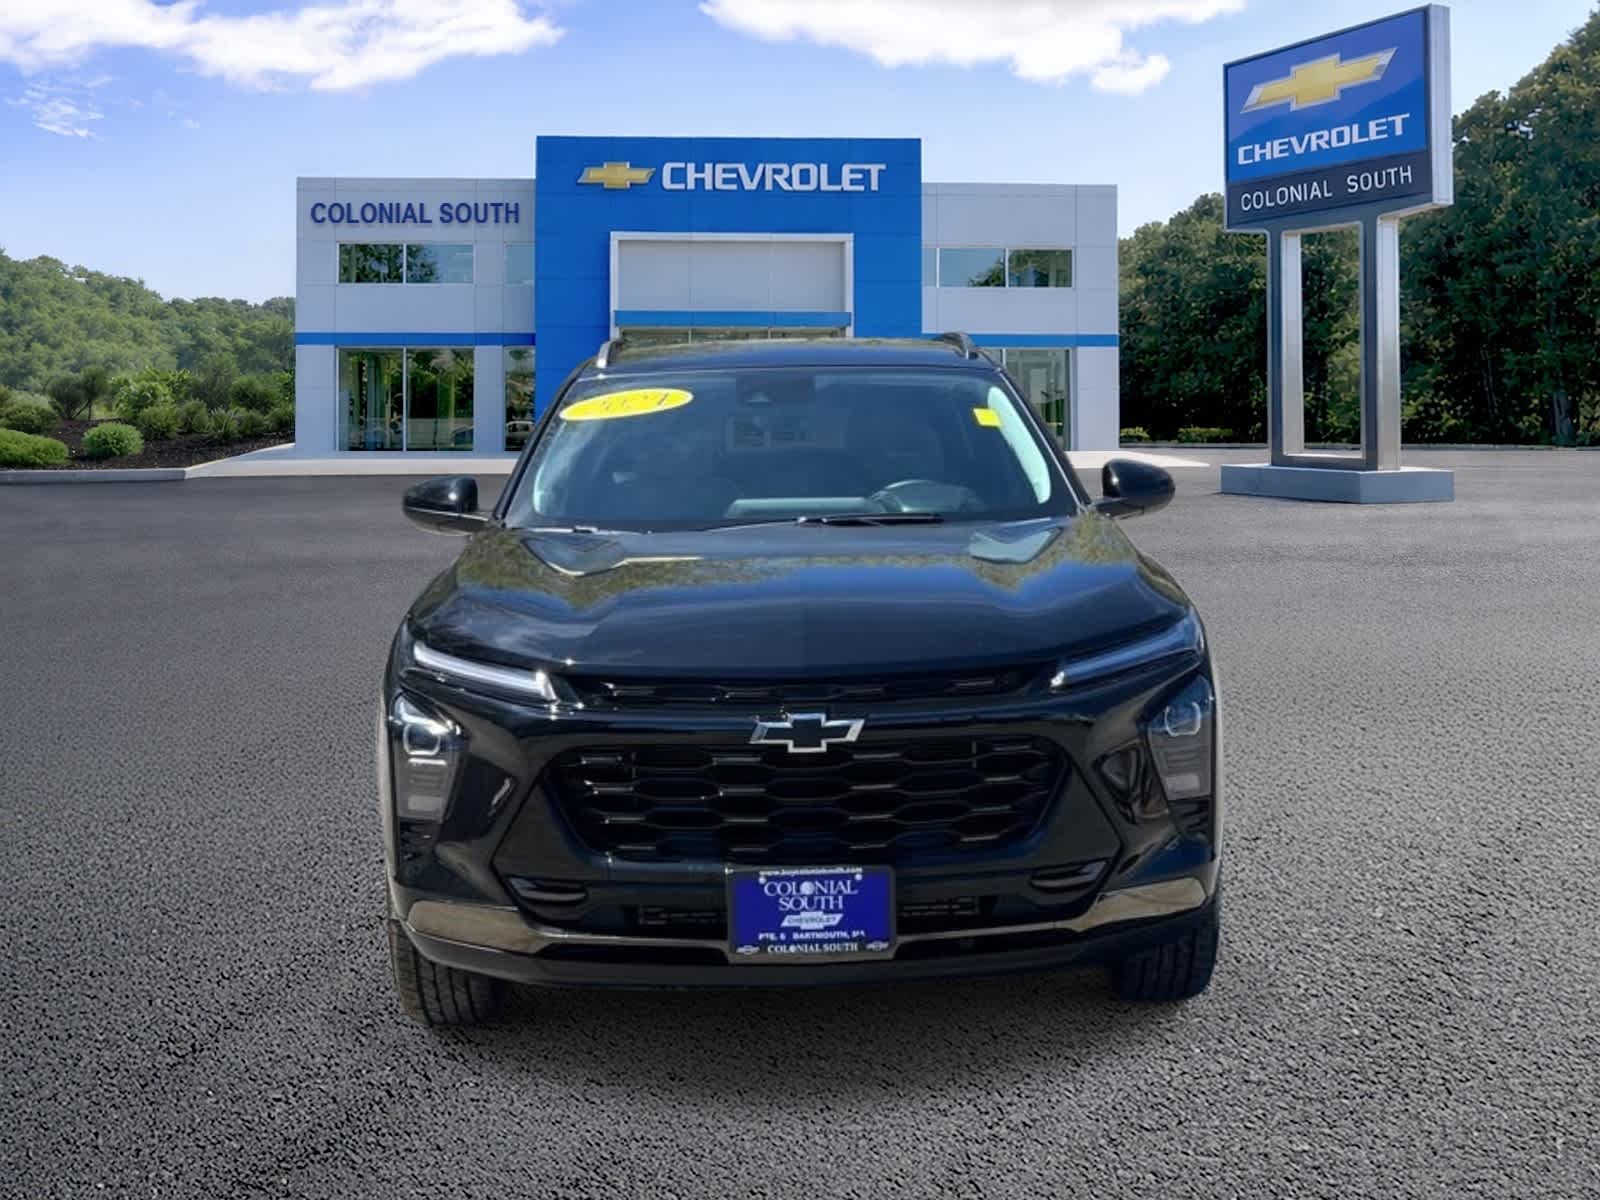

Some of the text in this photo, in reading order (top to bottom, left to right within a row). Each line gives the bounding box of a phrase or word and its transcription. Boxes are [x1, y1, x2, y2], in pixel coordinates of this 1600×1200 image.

[1237, 113, 1410, 165] CHEVROLET
[662, 162, 887, 192] CHEVROLET
[1240, 165, 1413, 212] COLONIAL SOUTH
[310, 202, 521, 225] COLONIAL SOUTH
[764, 880, 858, 896] COLONIAL
[779, 896, 843, 911] SOUTH
[768, 943, 858, 953] COLONIAL SOUTH
